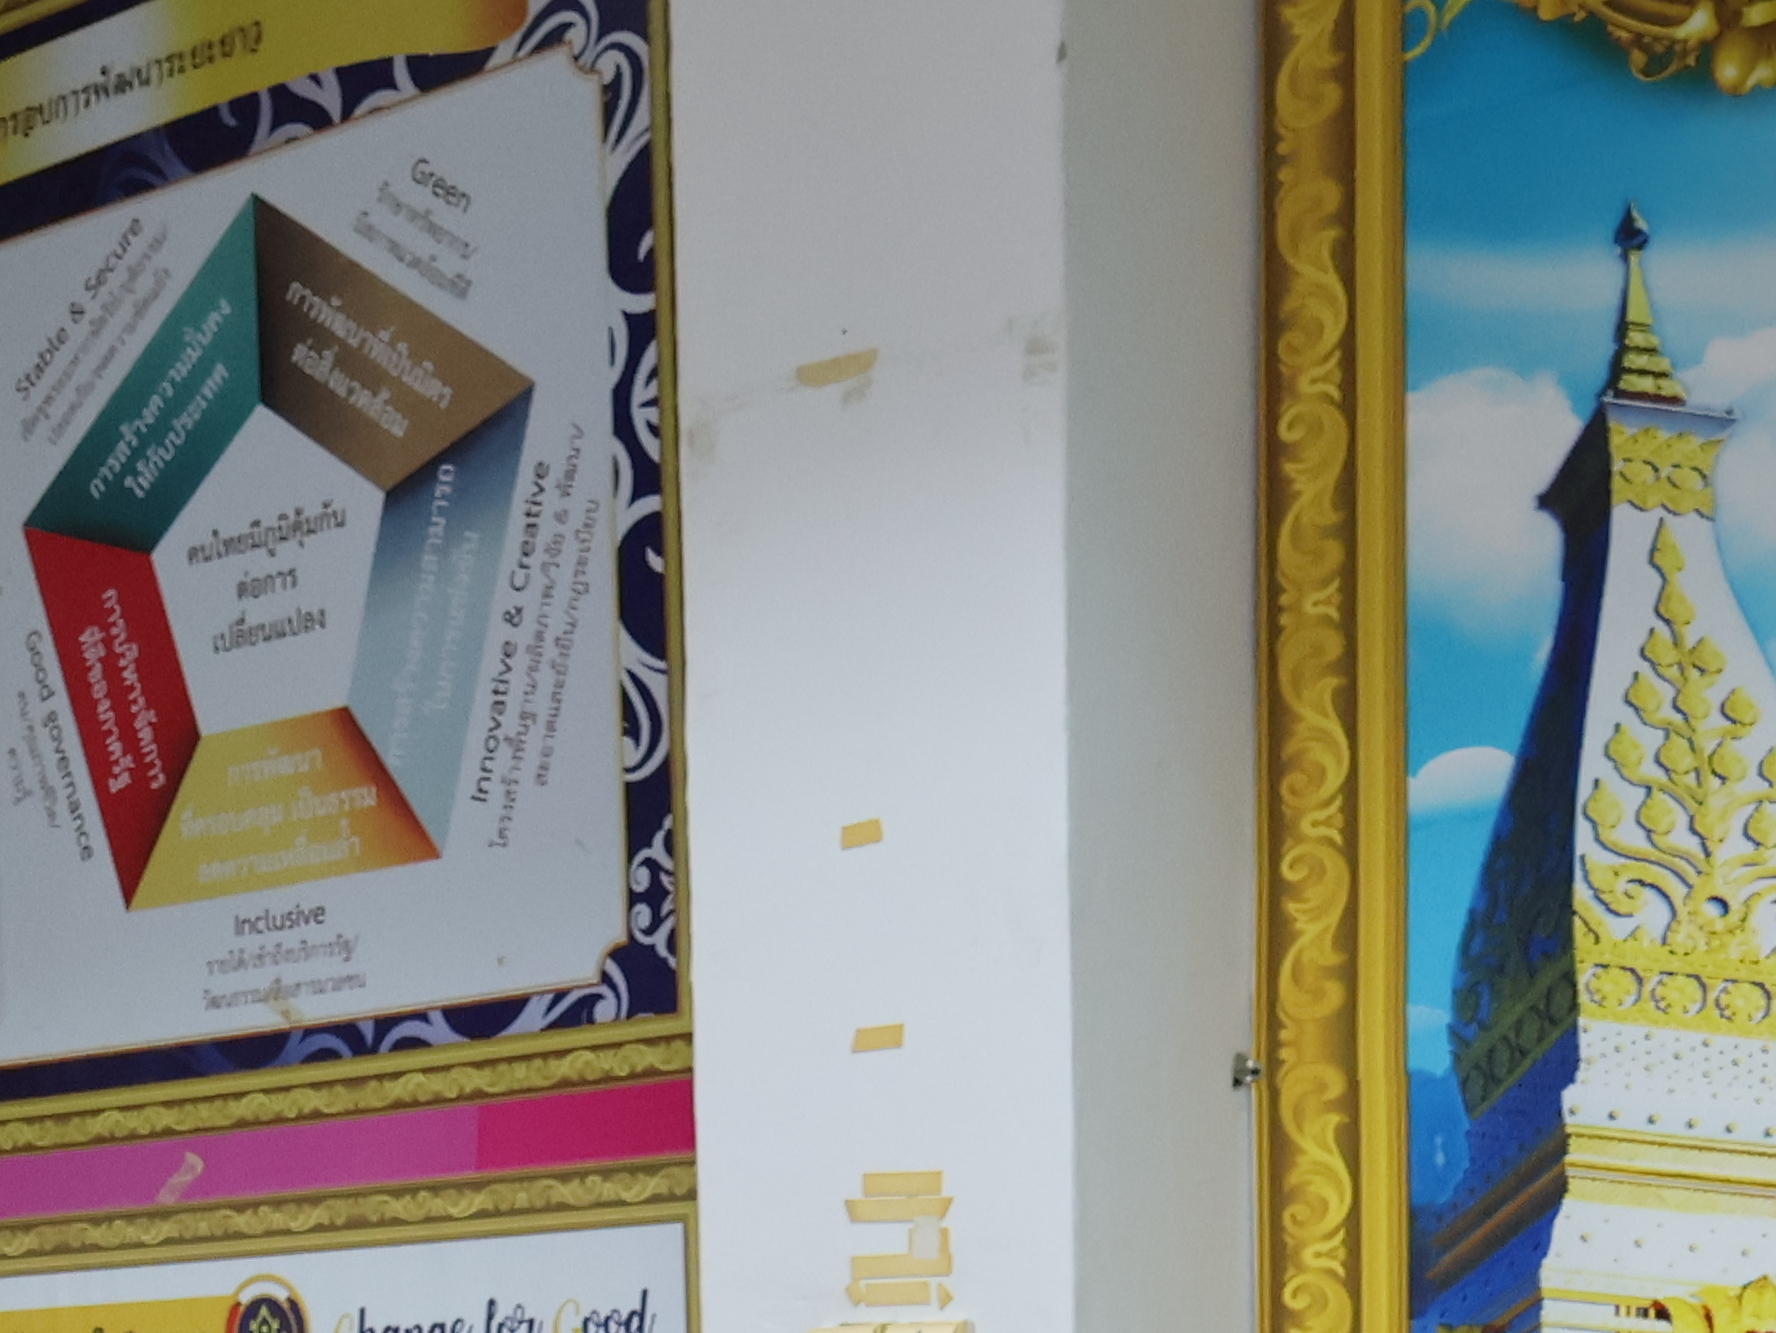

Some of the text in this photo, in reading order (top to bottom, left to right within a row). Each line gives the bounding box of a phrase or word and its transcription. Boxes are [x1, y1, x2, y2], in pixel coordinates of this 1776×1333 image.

[410, 156, 472, 214] Green
[15, 325, 71, 402] Stable
[83, 217, 144, 300] Secure
[471, 639, 519, 803] Innovative
[510, 459, 549, 594] Creative
[25, 629, 55, 703] Good
[41, 709, 95, 863] governance
[234, 902, 327, 937] Inclusive
